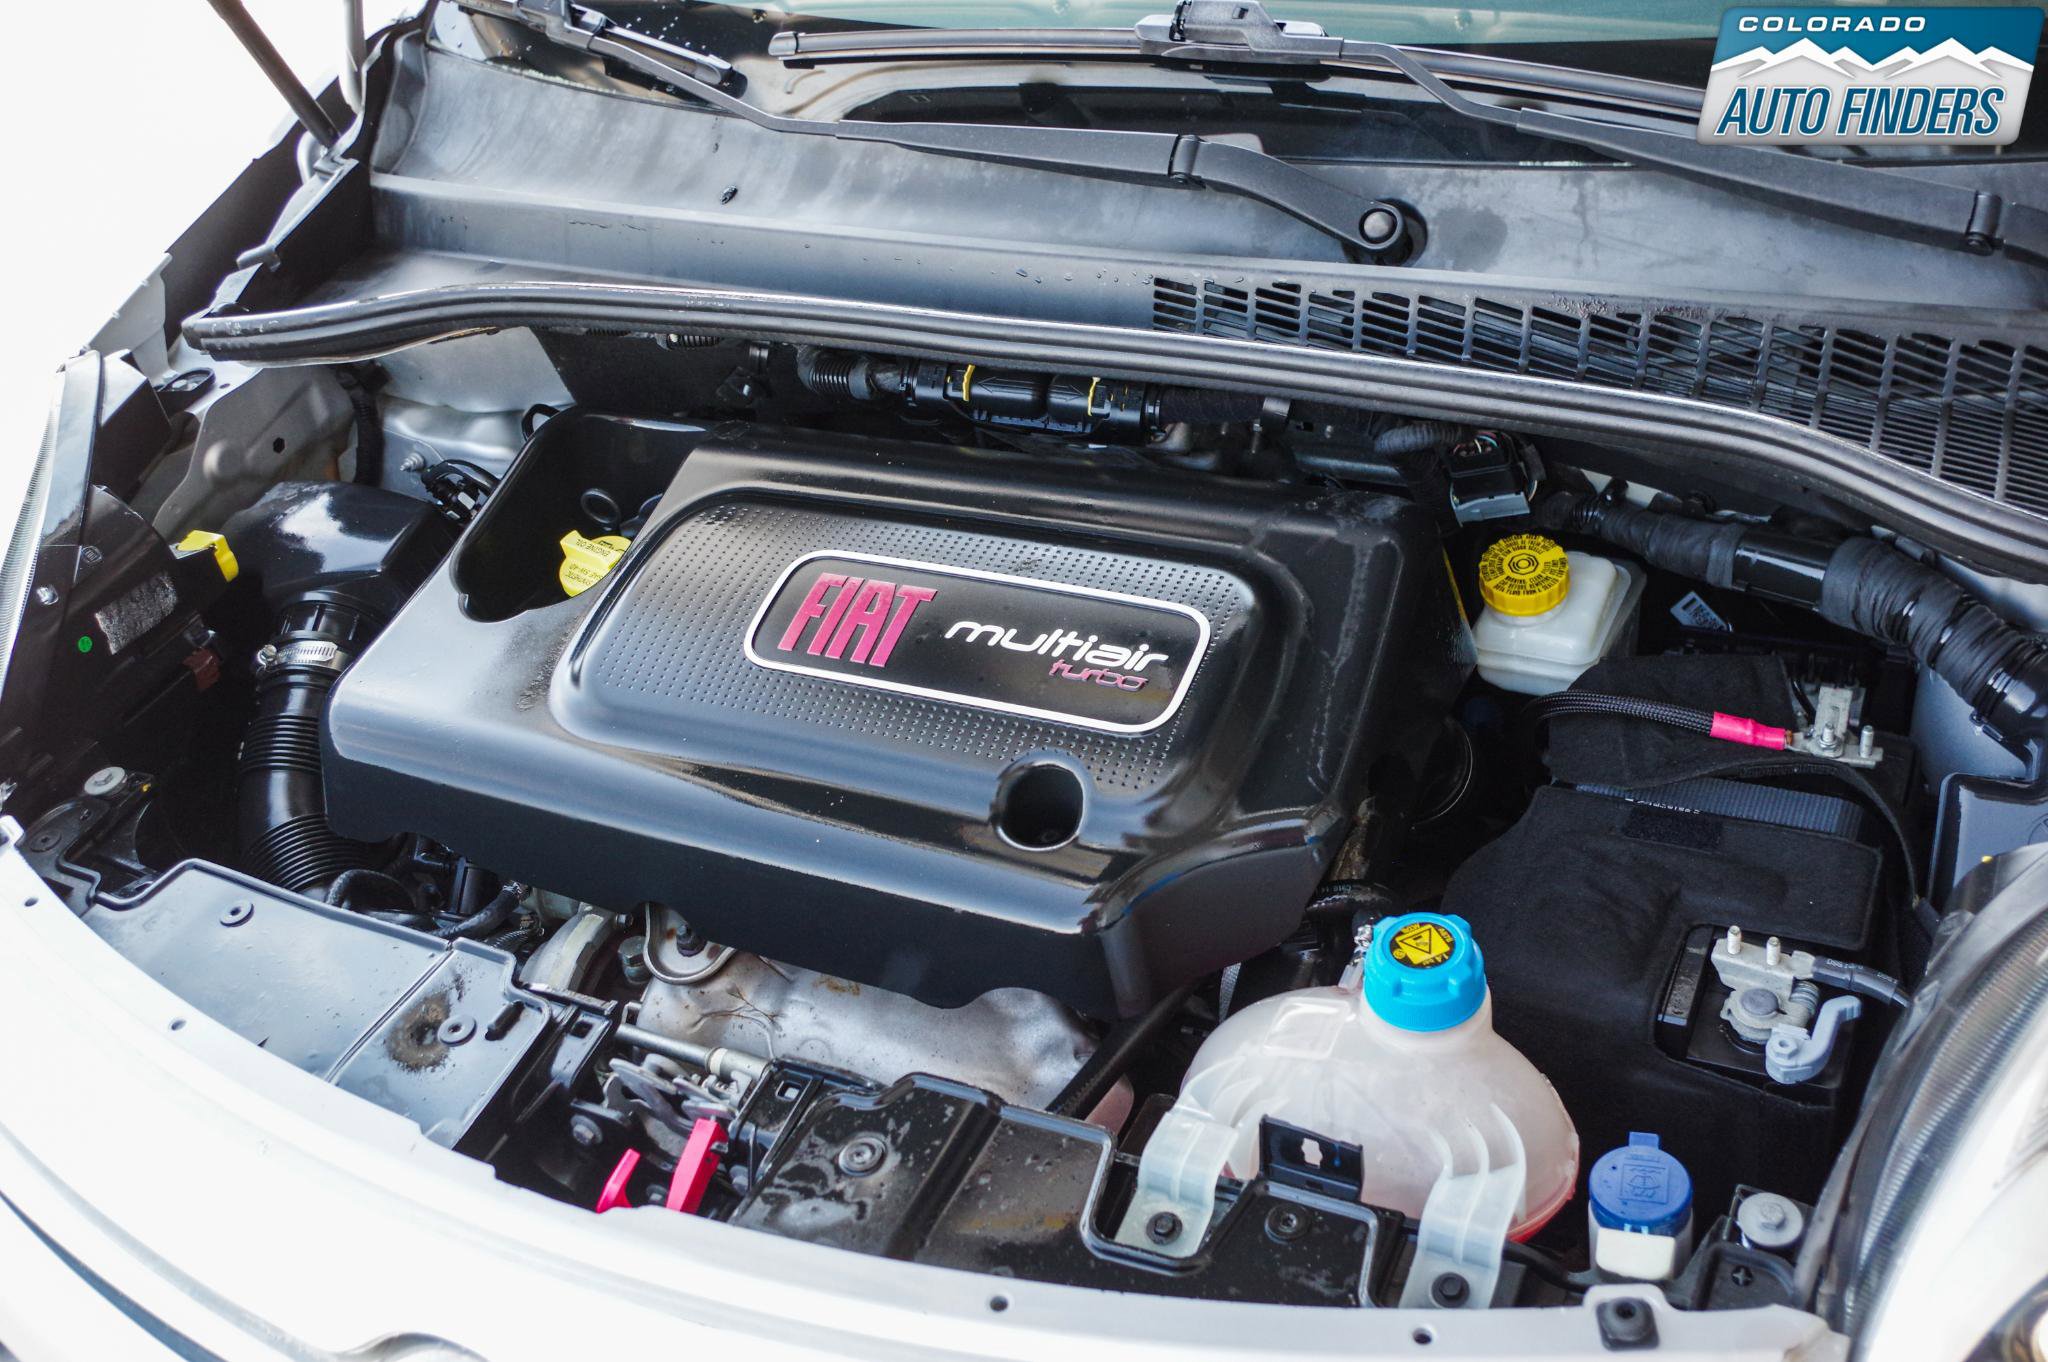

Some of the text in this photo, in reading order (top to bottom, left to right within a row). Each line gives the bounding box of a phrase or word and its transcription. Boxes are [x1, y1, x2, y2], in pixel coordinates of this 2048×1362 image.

[777, 572, 938, 668] FIAT
[944, 620, 1169, 672] multiair
[1049, 658, 1150, 693] turbo
